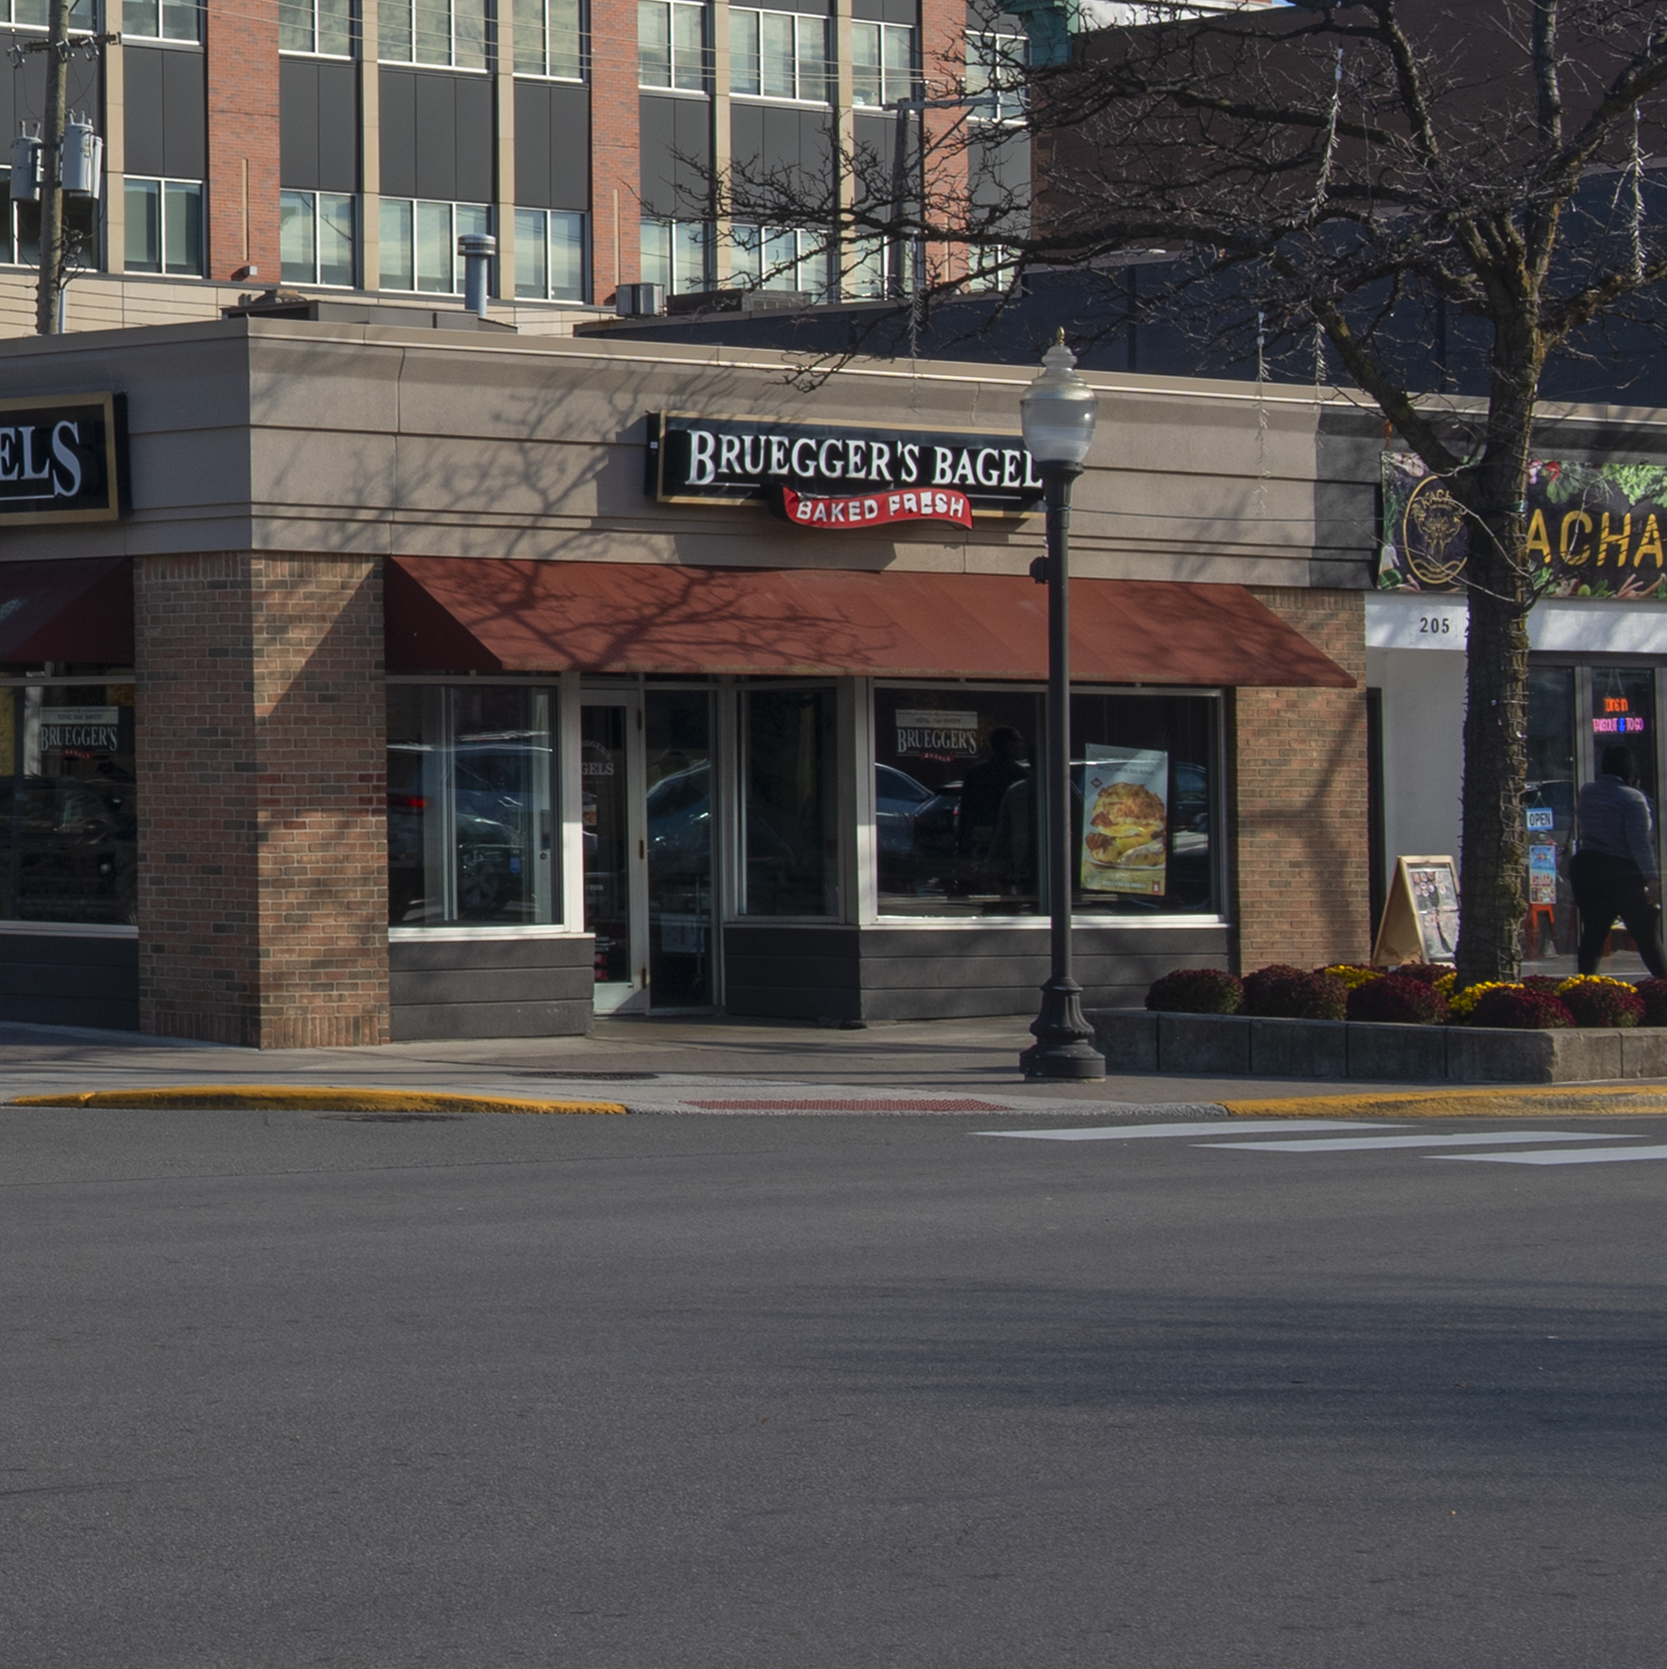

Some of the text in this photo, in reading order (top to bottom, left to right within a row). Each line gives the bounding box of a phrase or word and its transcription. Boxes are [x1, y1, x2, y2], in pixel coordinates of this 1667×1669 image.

[685, 429, 1043, 488] BRUEGGER'S BAGEL
[796, 491, 966, 523] BAKED FRESH
[1526, 507, 1665, 569] ACHA
[1419, 617, 1450, 635] 205
[41, 726, 117, 751] BRUEGGER'S
[896, 729, 977, 754] BRUEGGER'S
[582, 762, 614, 775] GELS
[1529, 813, 1551, 826] OPEN
